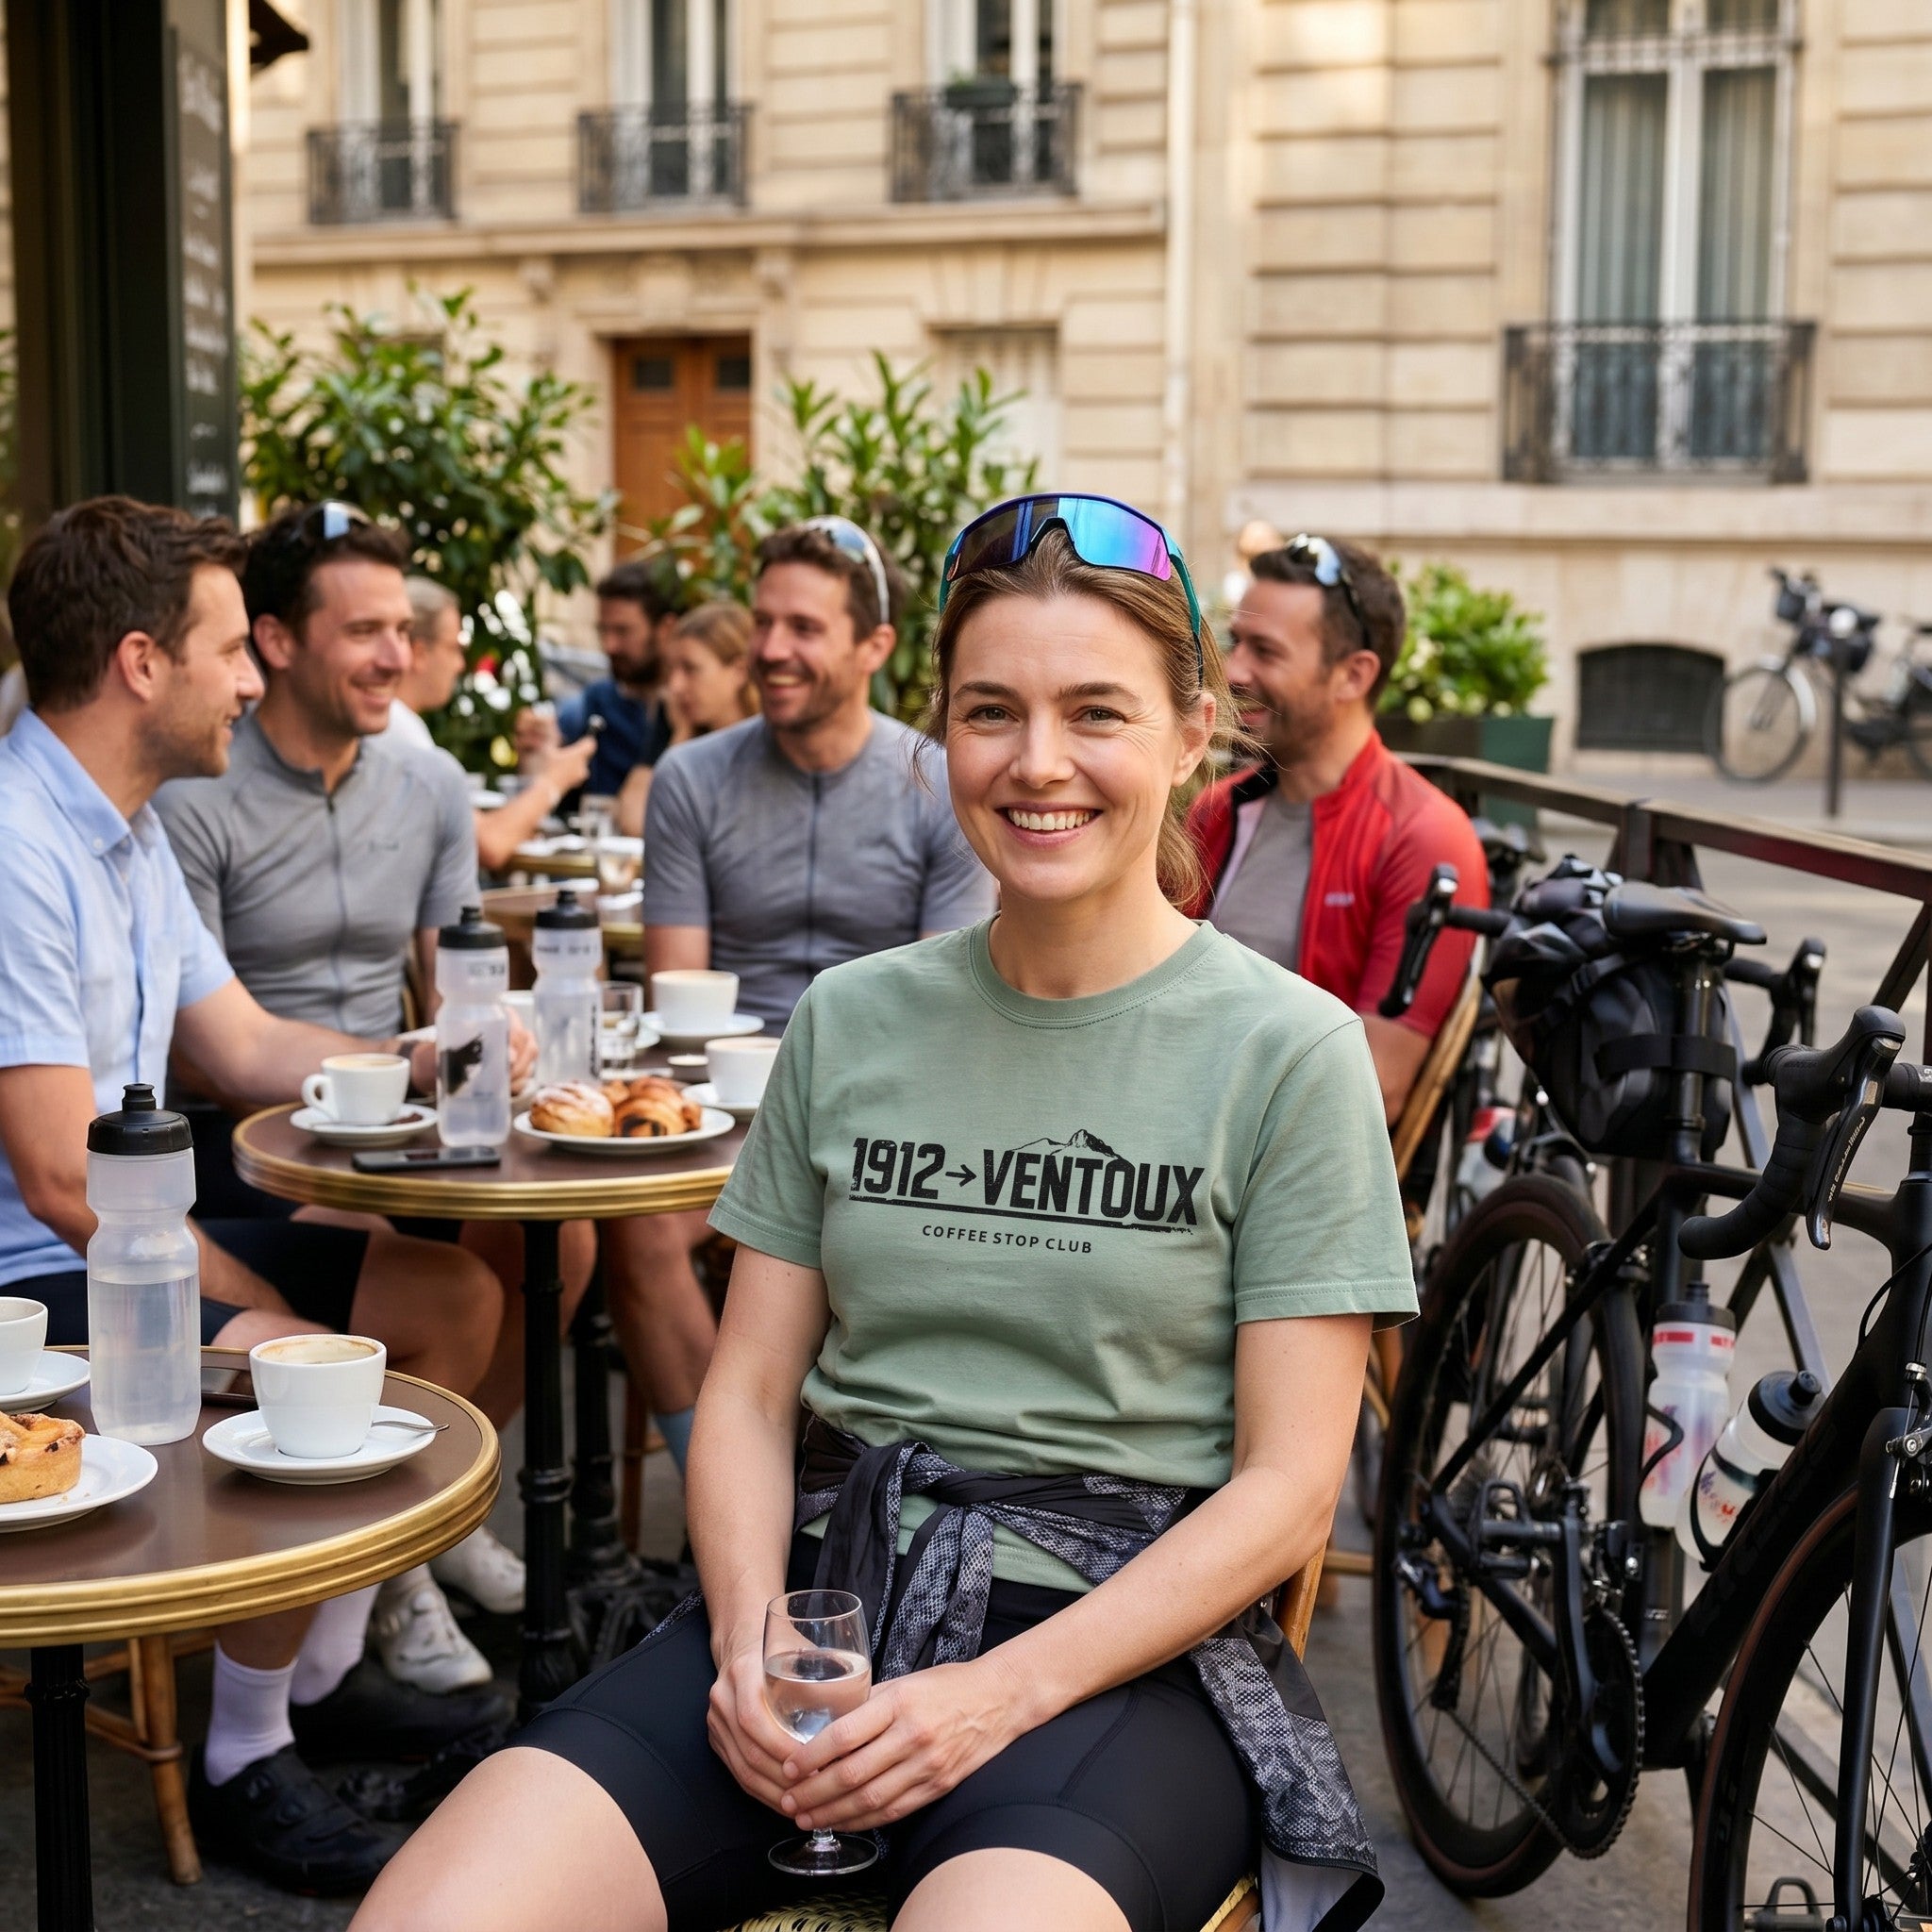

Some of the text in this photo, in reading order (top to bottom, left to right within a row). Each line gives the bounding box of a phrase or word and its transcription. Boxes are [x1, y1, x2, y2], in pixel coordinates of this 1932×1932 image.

[850, 1137, 1206, 1226] 1912 VENTOUX
[922, 1224, 1092, 1255] COFFEE STOP CLUB
